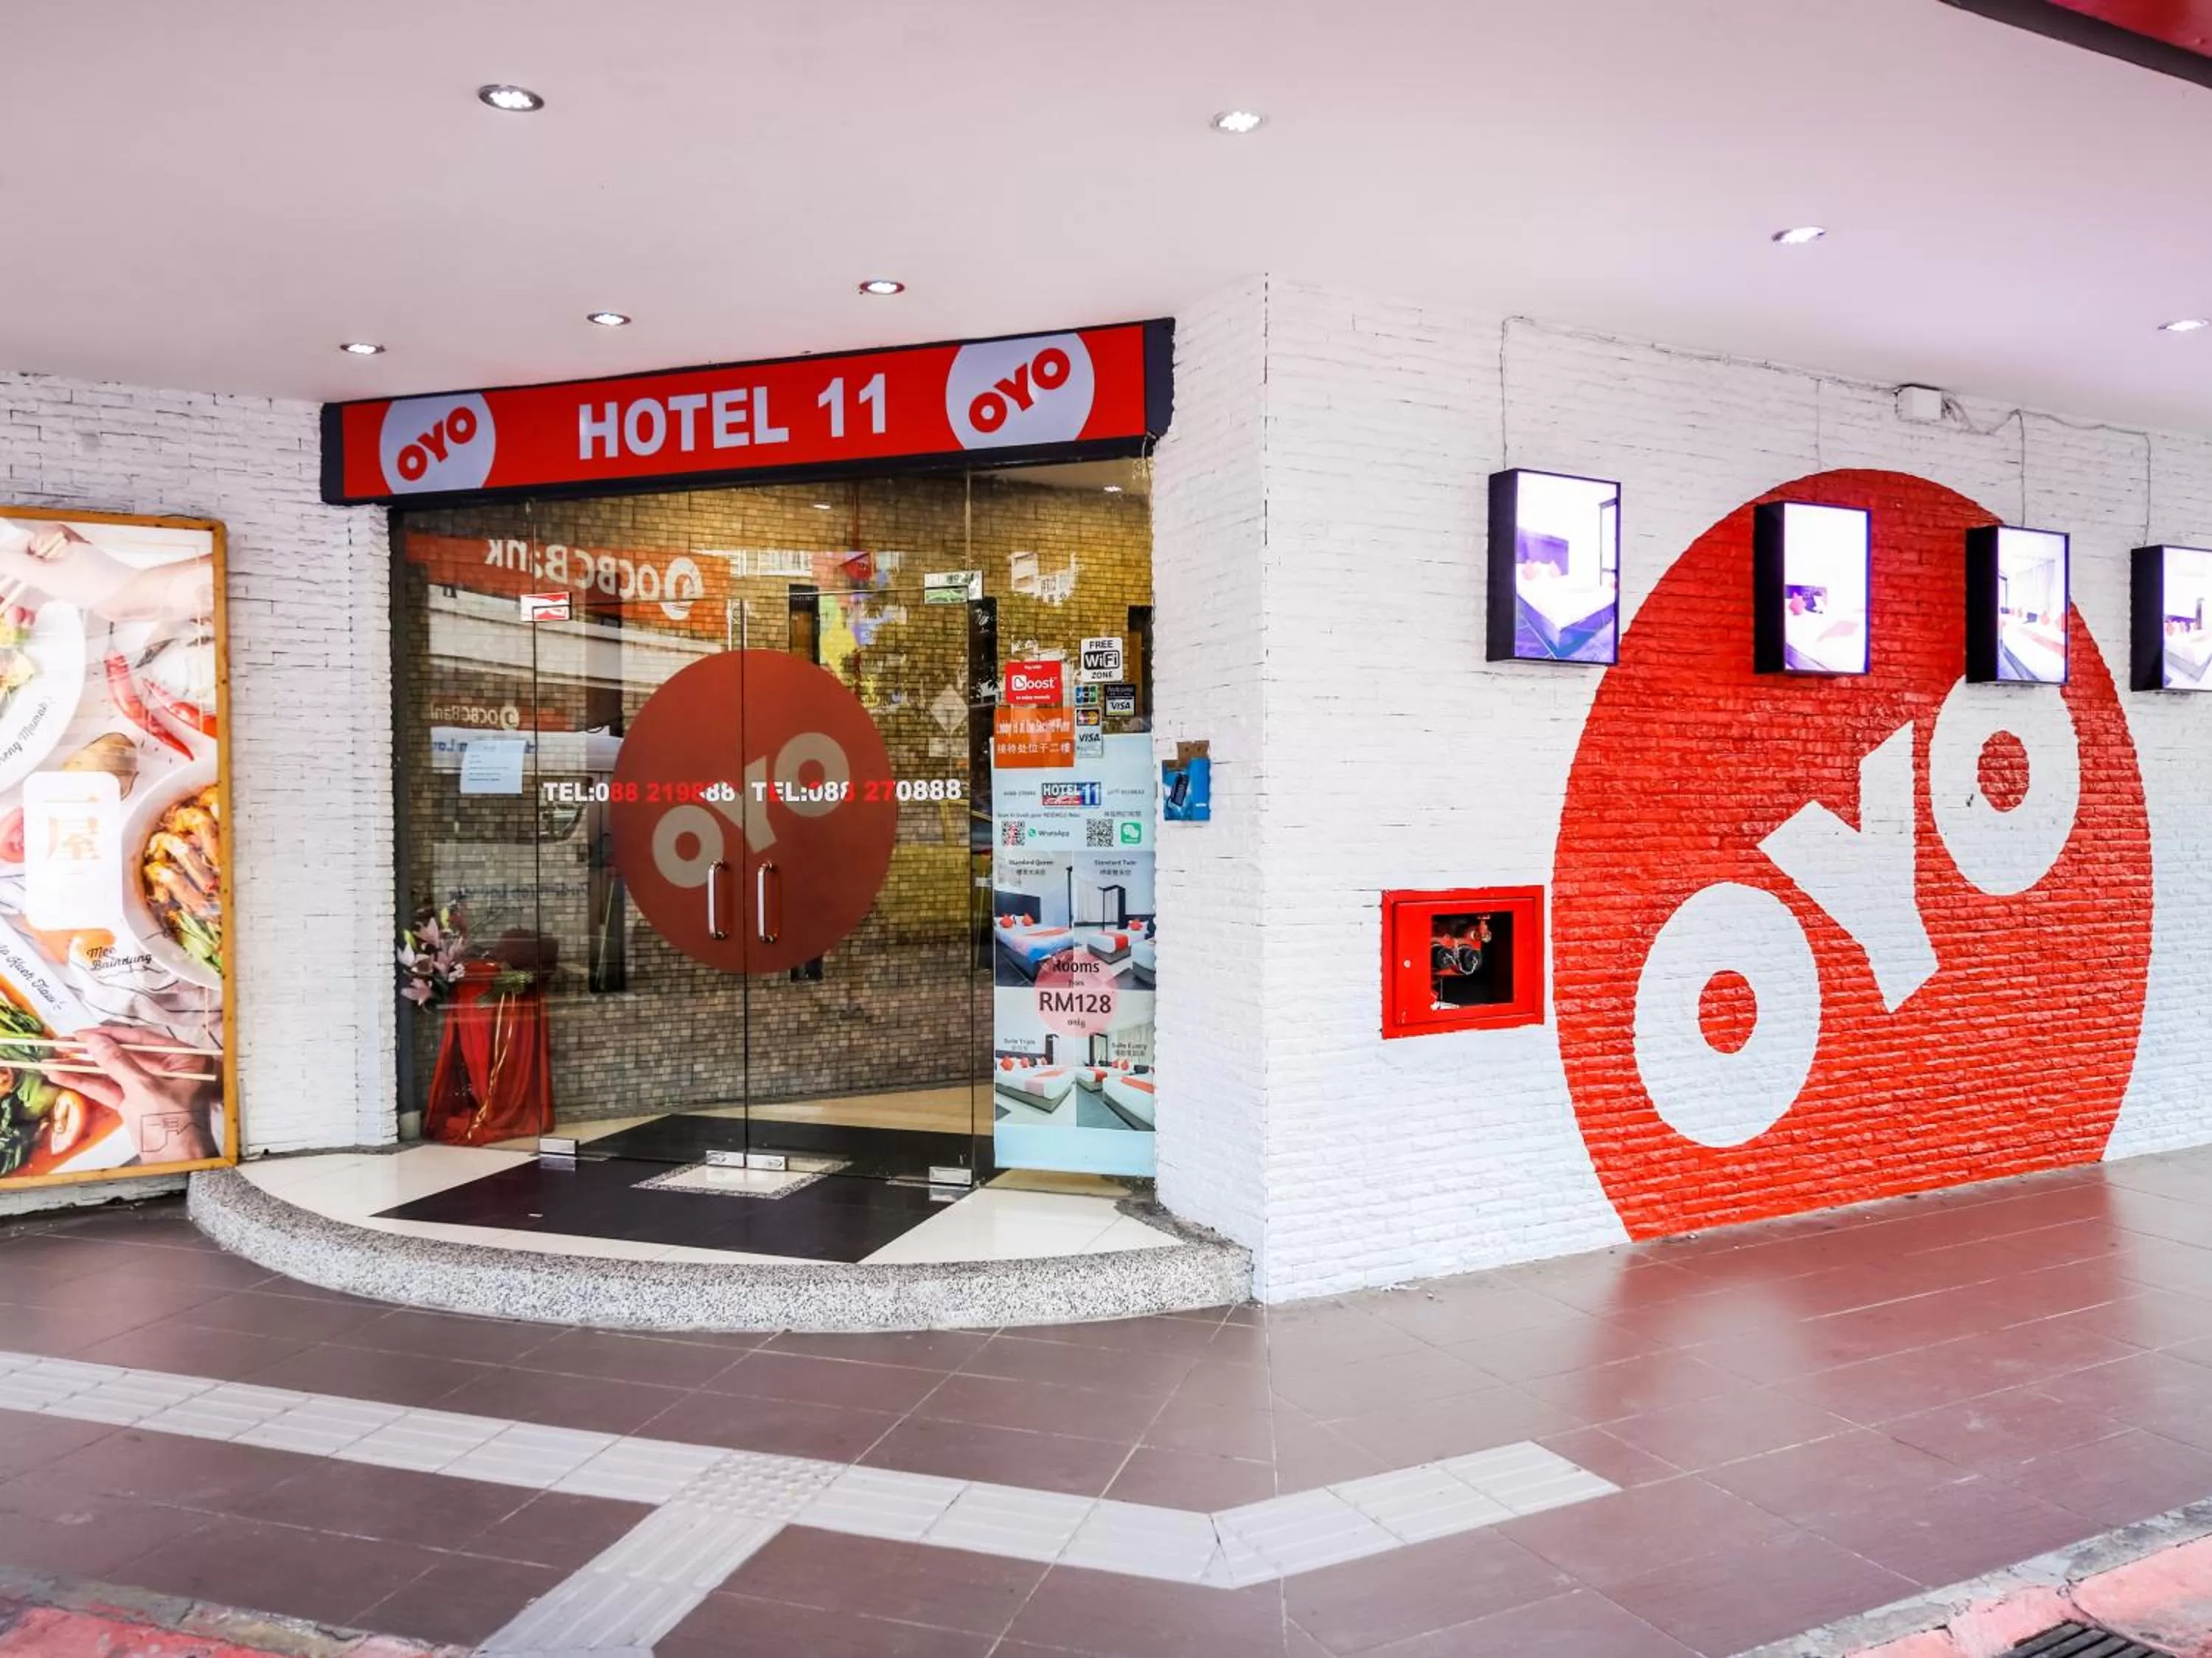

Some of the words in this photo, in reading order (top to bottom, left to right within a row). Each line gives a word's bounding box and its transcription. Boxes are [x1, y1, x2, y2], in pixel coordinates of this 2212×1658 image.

[969, 347, 1071, 433] OYO
[579, 386, 789, 460] HOTEL
[818, 372, 885, 437] 11
[397, 406, 477, 481] OYO
[1089, 639, 1114, 649] FREE
[1085, 653, 1118, 668] WiFi
[1092, 671, 1113, 679] ZONE
[1110, 701, 1130, 710] VISA
[1079, 733, 1100, 743] VISA
[543, 782, 638, 802] TEL:088
[752, 781, 855, 802] TEL:088
[863, 779, 962, 802] 270888
[1043, 784, 1079, 796] HOTEL
[1082, 784, 1099, 805] 11
[652, 731, 849, 889] OYO
[1634, 673, 2079, 1148] OYO
[1052, 959, 1100, 973] Rooms
[1039, 991, 1112, 1014] RM128
